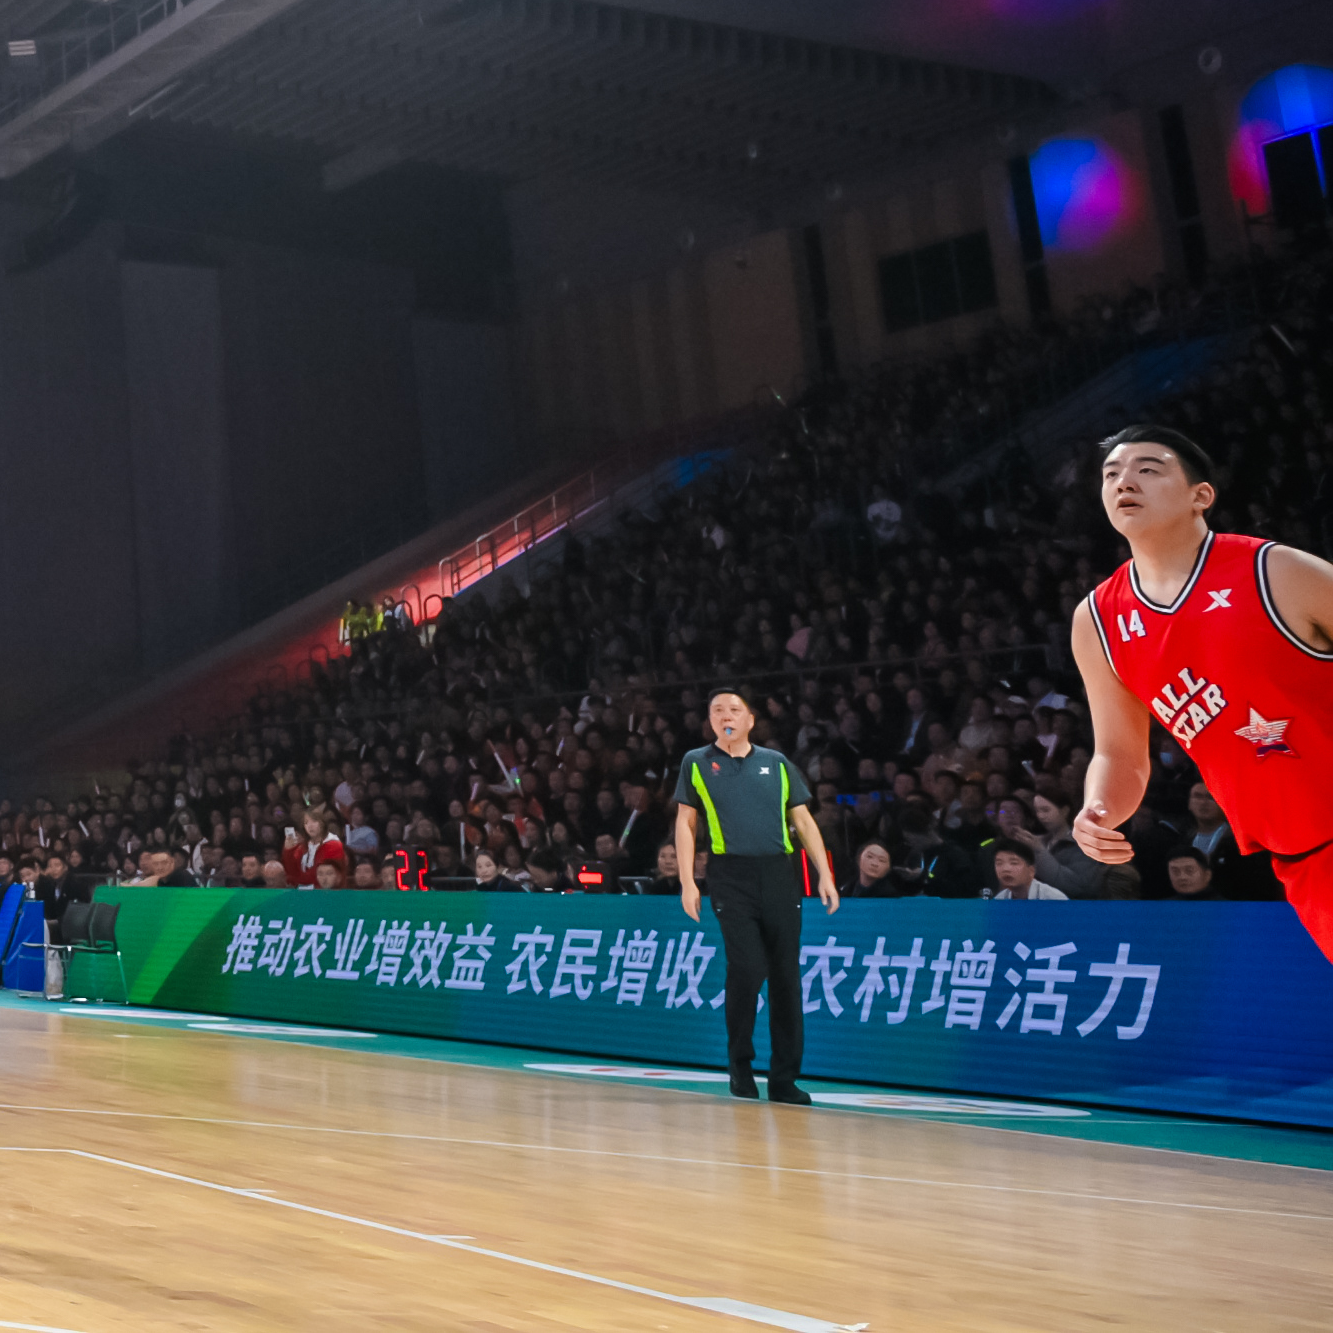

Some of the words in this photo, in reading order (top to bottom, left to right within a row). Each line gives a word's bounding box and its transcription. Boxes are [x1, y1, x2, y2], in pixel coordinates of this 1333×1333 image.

[1117, 609, 1147, 643] 14
[1151, 667, 1208, 725] ALL
[1172, 683, 1229, 749] STAR
[221, 913, 496, 990] 推动农业增效益
[505, 925, 761, 1013] 农民增收
[799, 935, 1162, 1040] 农村增活力
